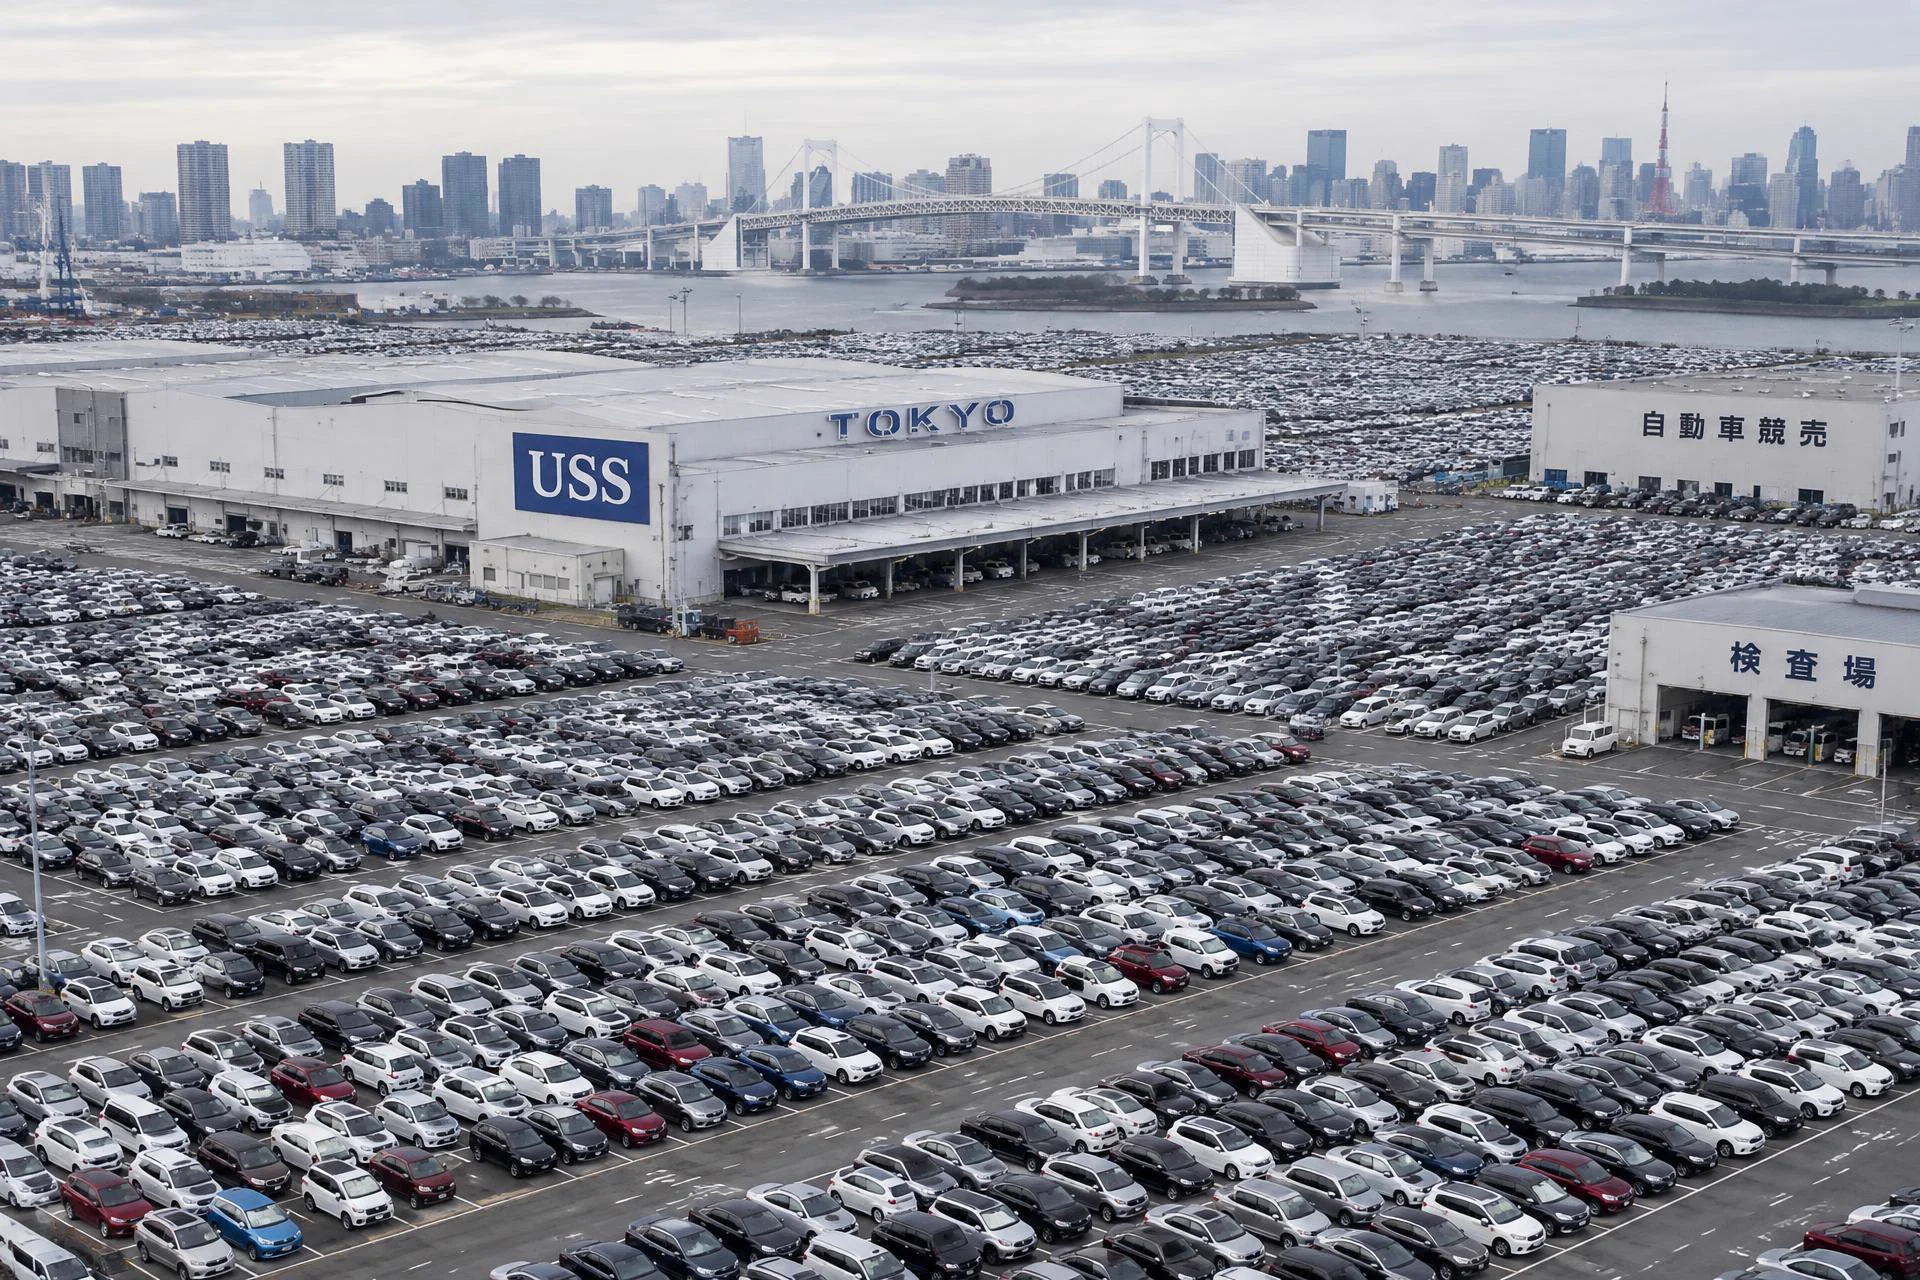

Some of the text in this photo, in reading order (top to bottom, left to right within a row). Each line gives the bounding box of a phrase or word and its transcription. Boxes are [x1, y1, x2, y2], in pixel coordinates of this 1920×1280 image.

[829, 399, 1016, 439] TOKYO
[1642, 410, 1828, 448] 自動車競売
[528, 450, 631, 505] USS
[1729, 640, 1877, 689] 検査場
